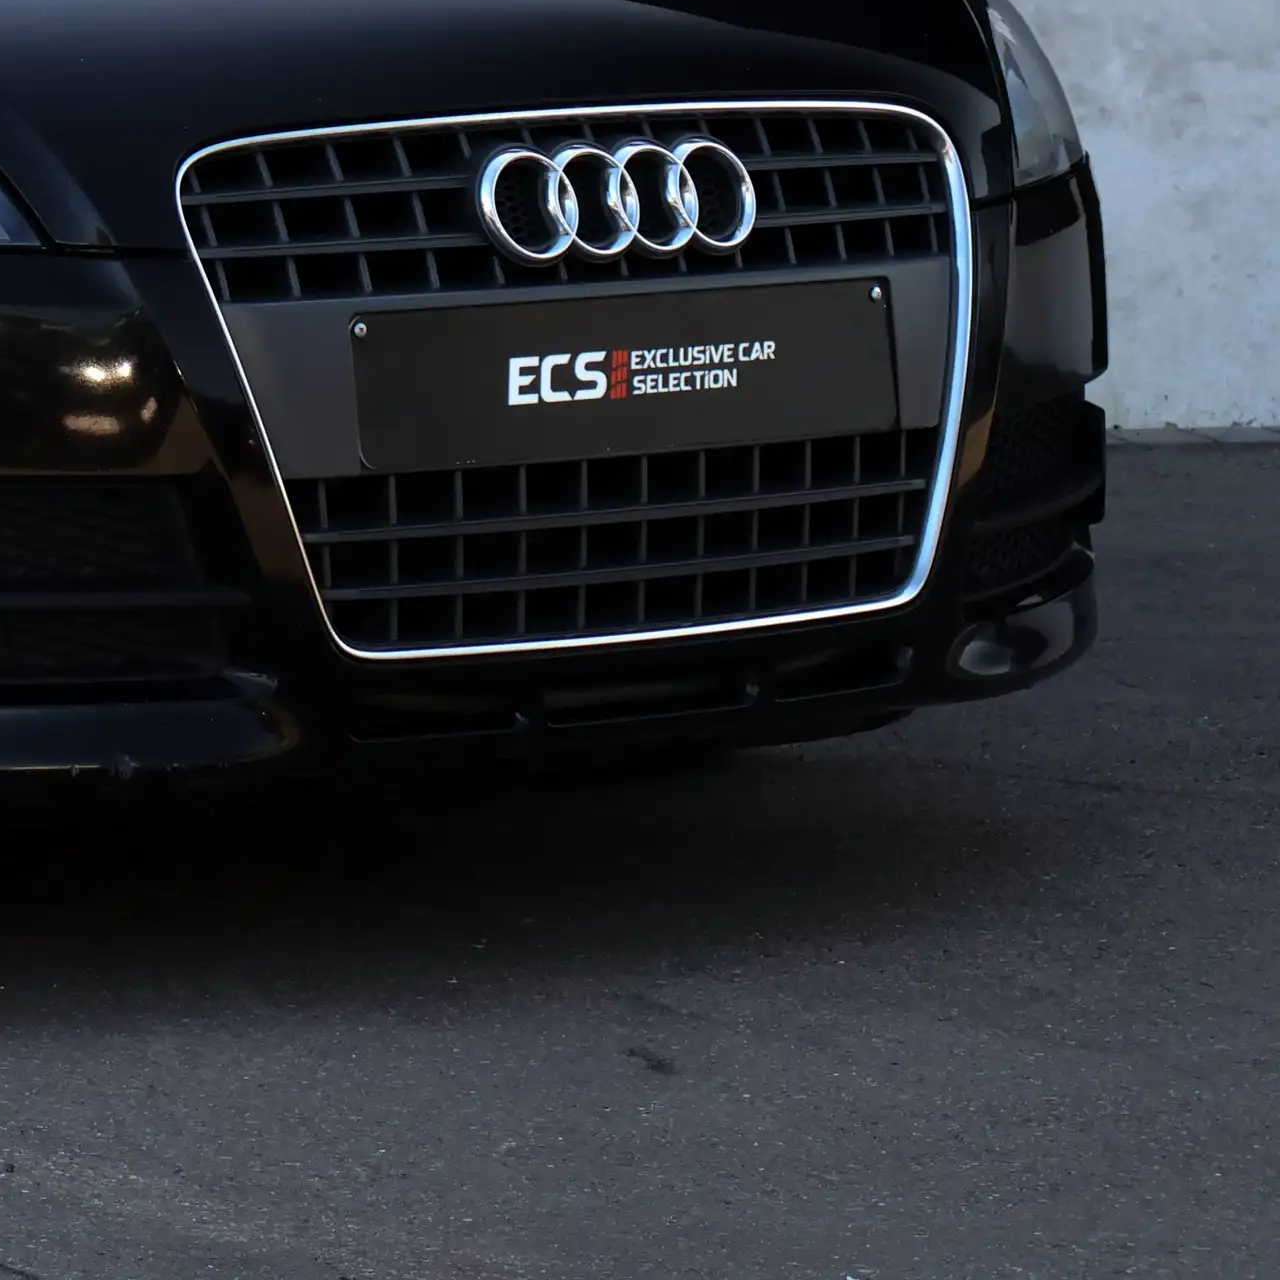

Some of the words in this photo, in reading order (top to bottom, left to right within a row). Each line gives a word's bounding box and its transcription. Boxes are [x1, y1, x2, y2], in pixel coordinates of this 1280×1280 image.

[630, 343, 735, 370] EXCLUSIVE
[738, 340, 776, 362] CAR
[507, 350, 608, 406] ECS
[631, 367, 738, 395] SELECTION
